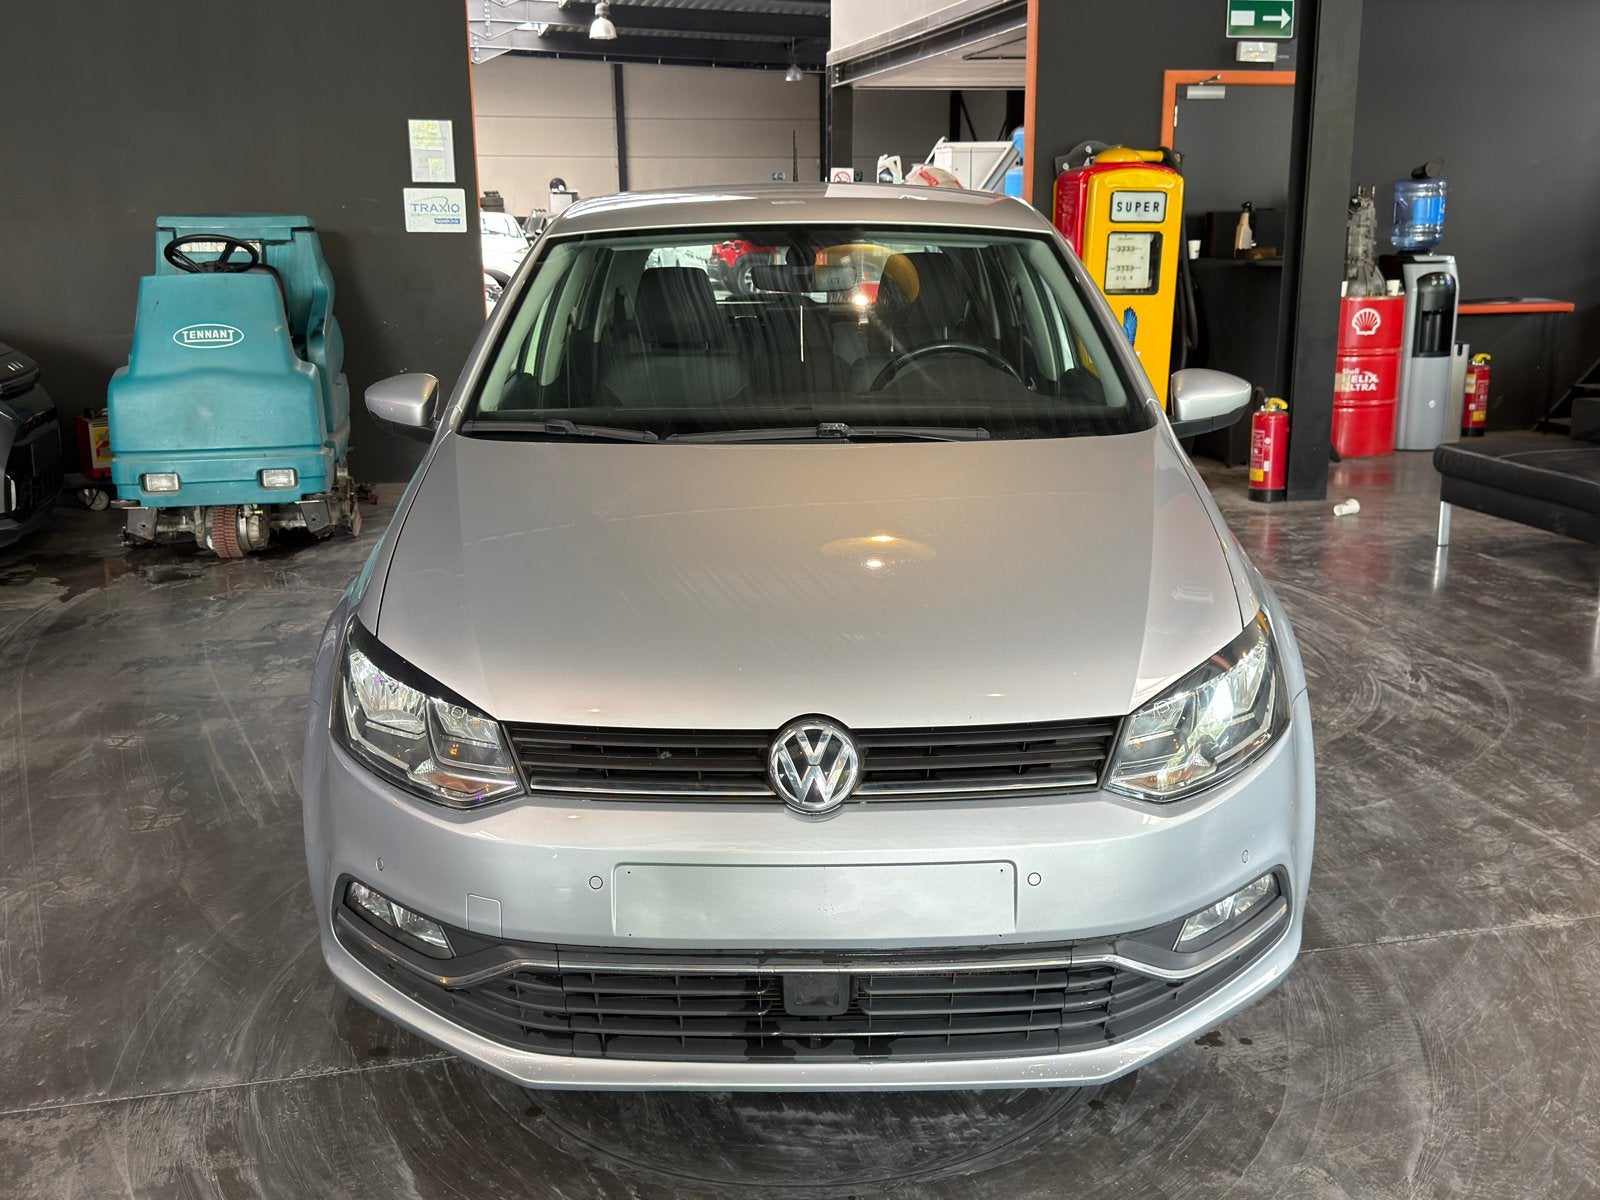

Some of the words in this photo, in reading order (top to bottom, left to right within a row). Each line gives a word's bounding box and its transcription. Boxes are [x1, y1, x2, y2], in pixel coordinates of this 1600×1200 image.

[410, 201, 460, 213] TRAXIO
[1116, 202, 1160, 212] SUPER
[182, 330, 234, 343] TENNANT
[1343, 374, 1379, 383] ELIX
[1343, 383, 1377, 392] LTRA
